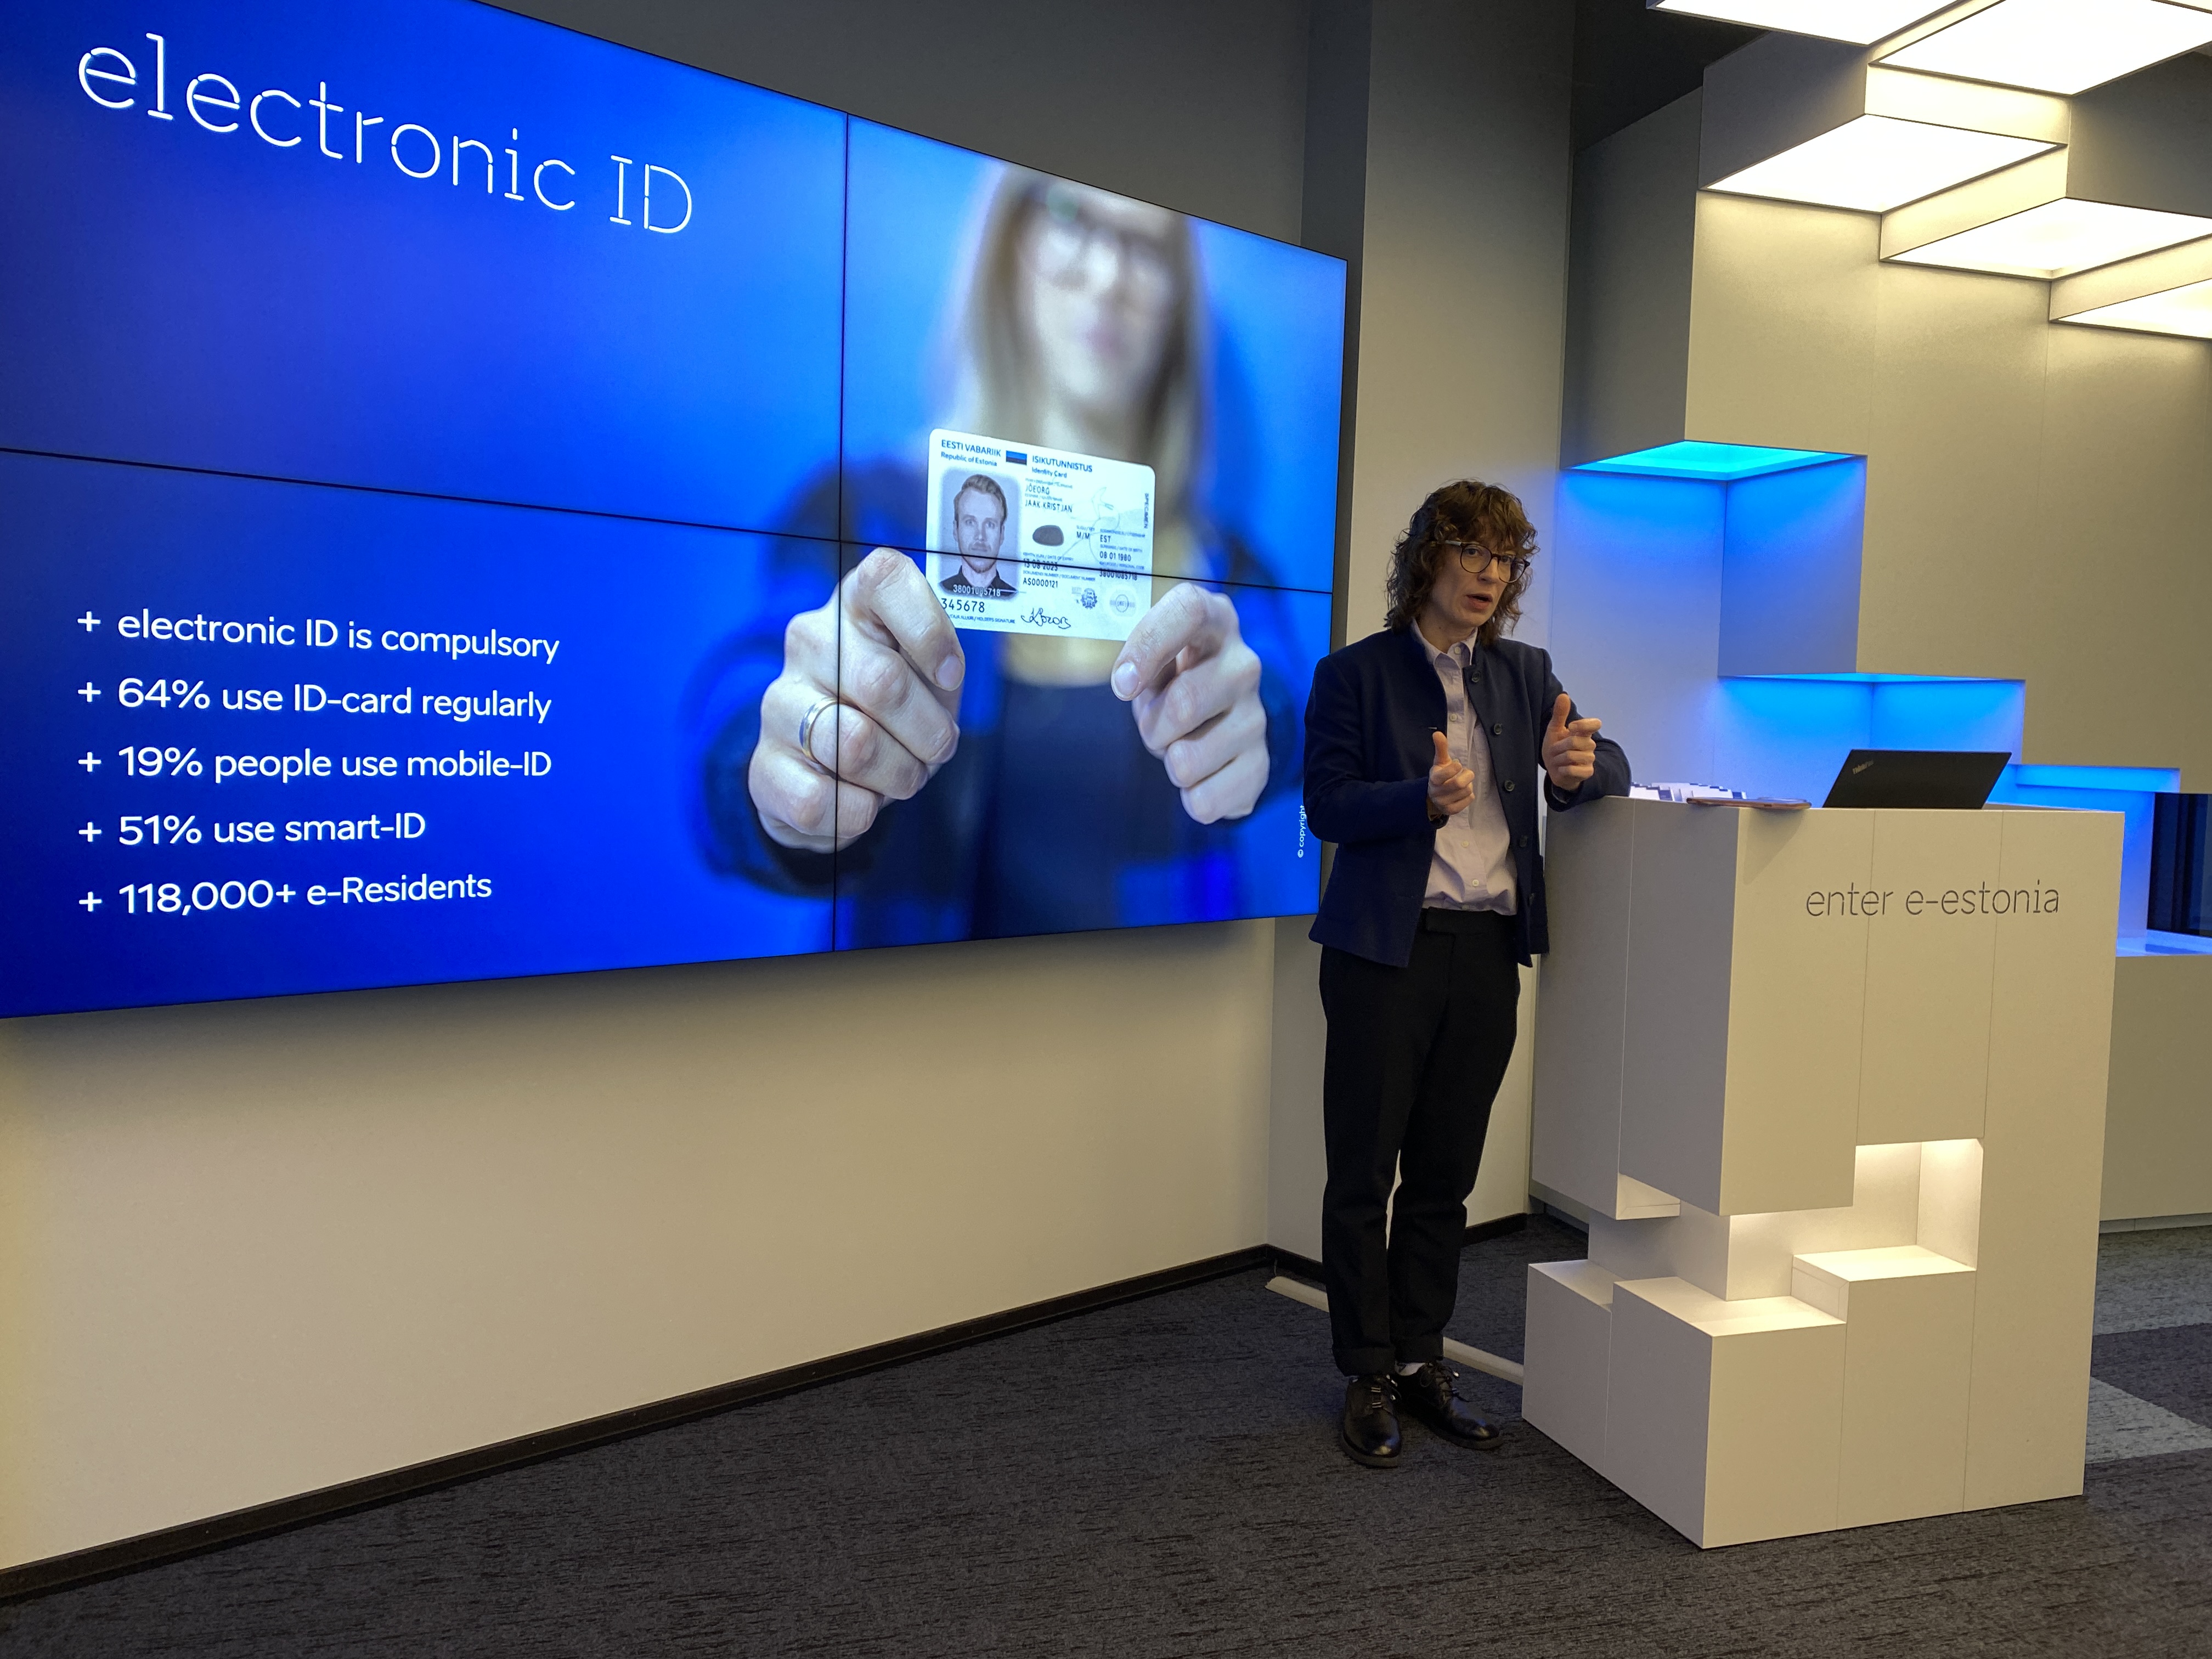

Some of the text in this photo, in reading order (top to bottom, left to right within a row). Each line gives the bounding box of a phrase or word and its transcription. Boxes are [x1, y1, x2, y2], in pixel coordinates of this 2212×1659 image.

[78, 32, 693, 234] electronic ID
[941, 439, 1001, 457] EESTI VABARIIK
[941, 451, 967, 462] Republic
[975, 457, 997, 466] Estonia
[1032, 455, 1092, 472] ISIKUTUNNISTUS
[1032, 466, 1067, 478] Identity Card
[1100, 534, 1111, 543] EST
[1099, 551, 1107, 559] 08
[1023, 577, 1058, 588] AS0000121
[941, 597, 985, 613] 345678
[118, 608, 295, 646] electronic
[306, 619, 338, 647] ID
[349, 620, 372, 649] is
[381, 629, 560, 664] compulsory
[119, 678, 211, 709] 64%
[223, 689, 283, 711] use
[295, 684, 411, 714] ID-card
[422, 690, 552, 724] regularly
[119, 746, 203, 776] 19%
[215, 748, 331, 783] people
[342, 757, 398, 776] use
[408, 749, 551, 776] mobile-ID
[119, 815, 202, 845] 51%
[214, 821, 275, 843] use
[285, 812, 426, 842] smart-ID
[1299, 804, 1307, 848] copyright
[119, 879, 296, 916] 118,000+
[307, 873, 492, 905] e-Residents
[1806, 879, 2060, 917] enter e-estonia
